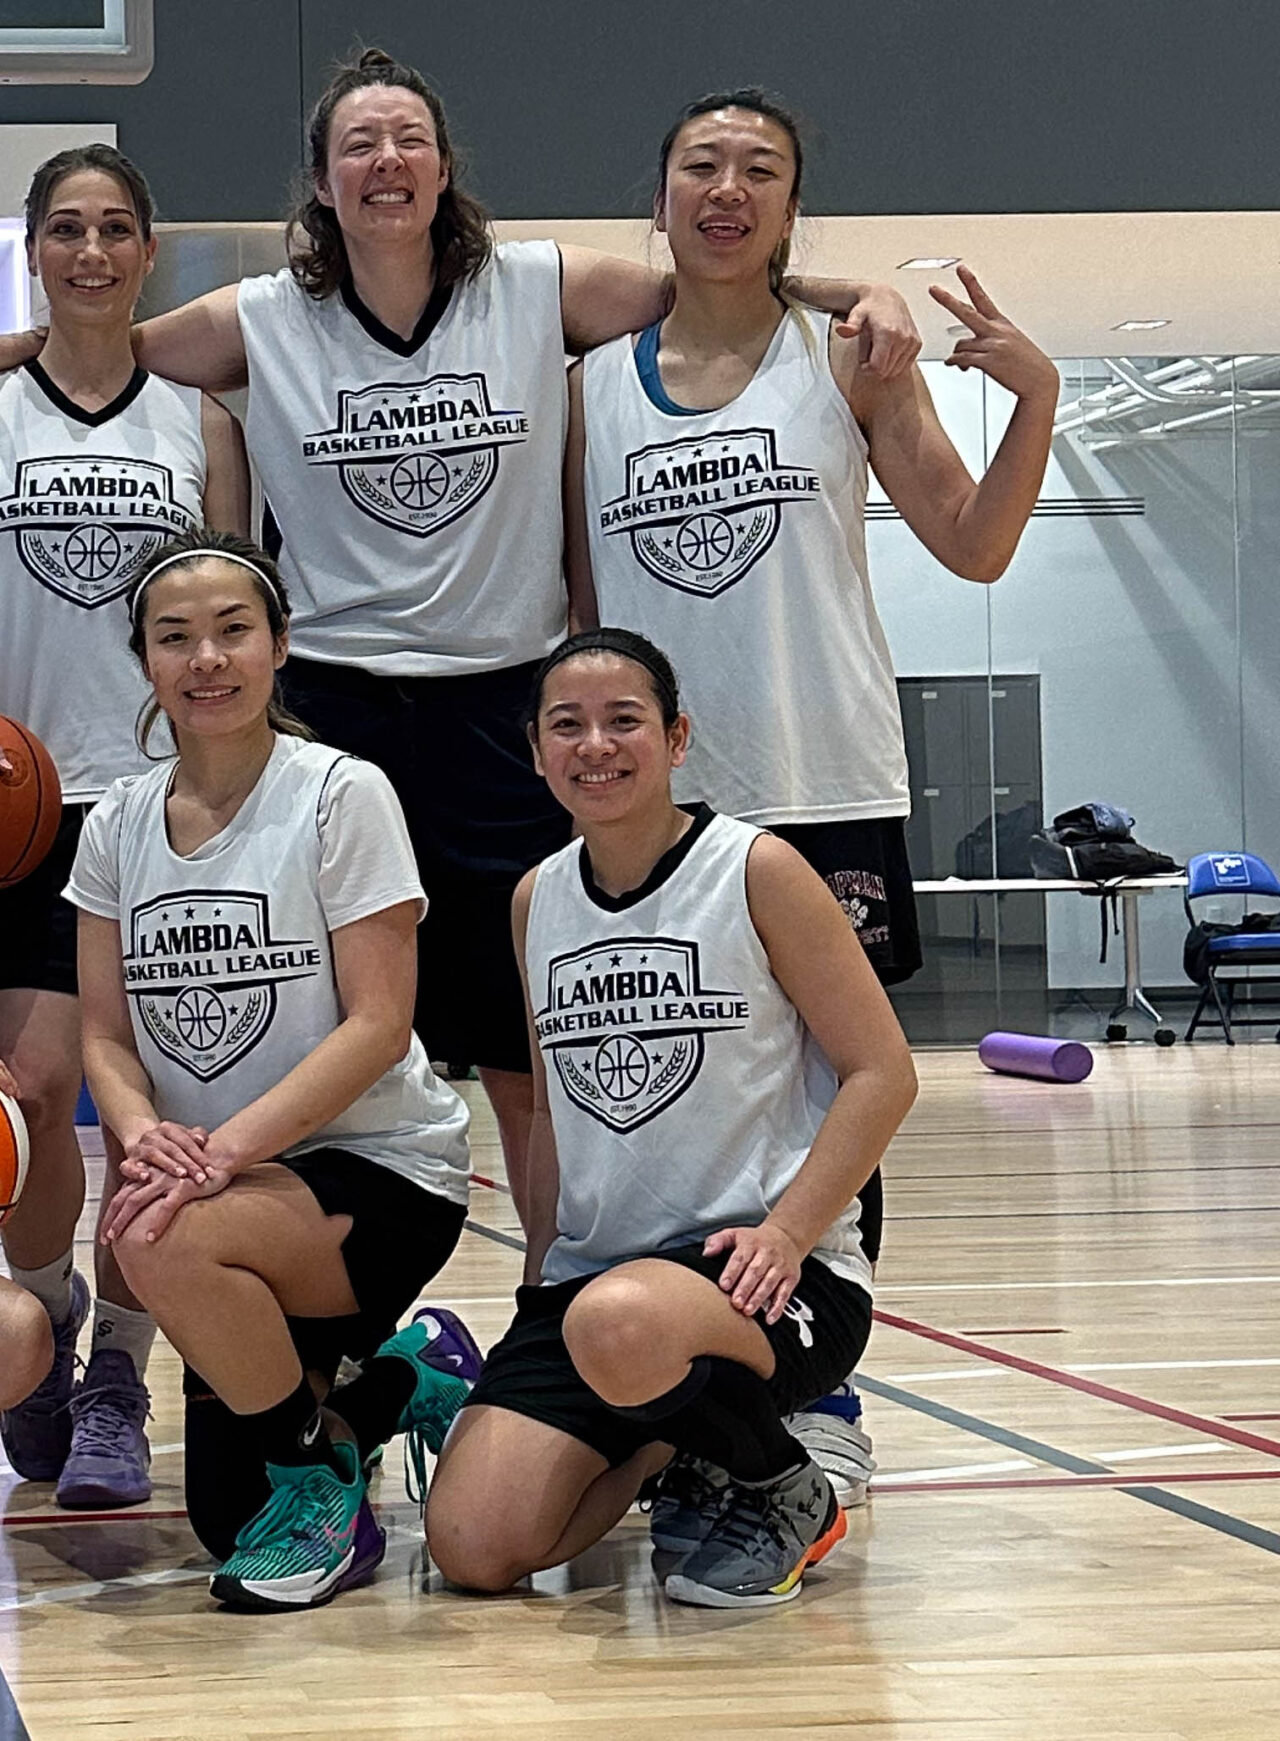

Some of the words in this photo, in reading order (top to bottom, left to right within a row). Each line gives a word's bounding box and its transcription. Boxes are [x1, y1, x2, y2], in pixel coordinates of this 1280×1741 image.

[351, 399, 481, 433] LAMBDA
[303, 429, 445, 457] BASKETBALL
[452, 418, 529, 440] LEAGUE
[29, 477, 161, 501] LAMBDA
[637, 453, 765, 496] LAMBDA
[601, 488, 727, 528] BASKETBALL
[734, 475, 820, 497] LEAGUE
[140, 924, 257, 958] LAMBDA
[124, 959, 219, 981] SKETBALL
[226, 949, 320, 974] LEAGUE
[558, 971, 686, 1010] LAMBDA
[651, 1002, 749, 1021] LEAGUE
